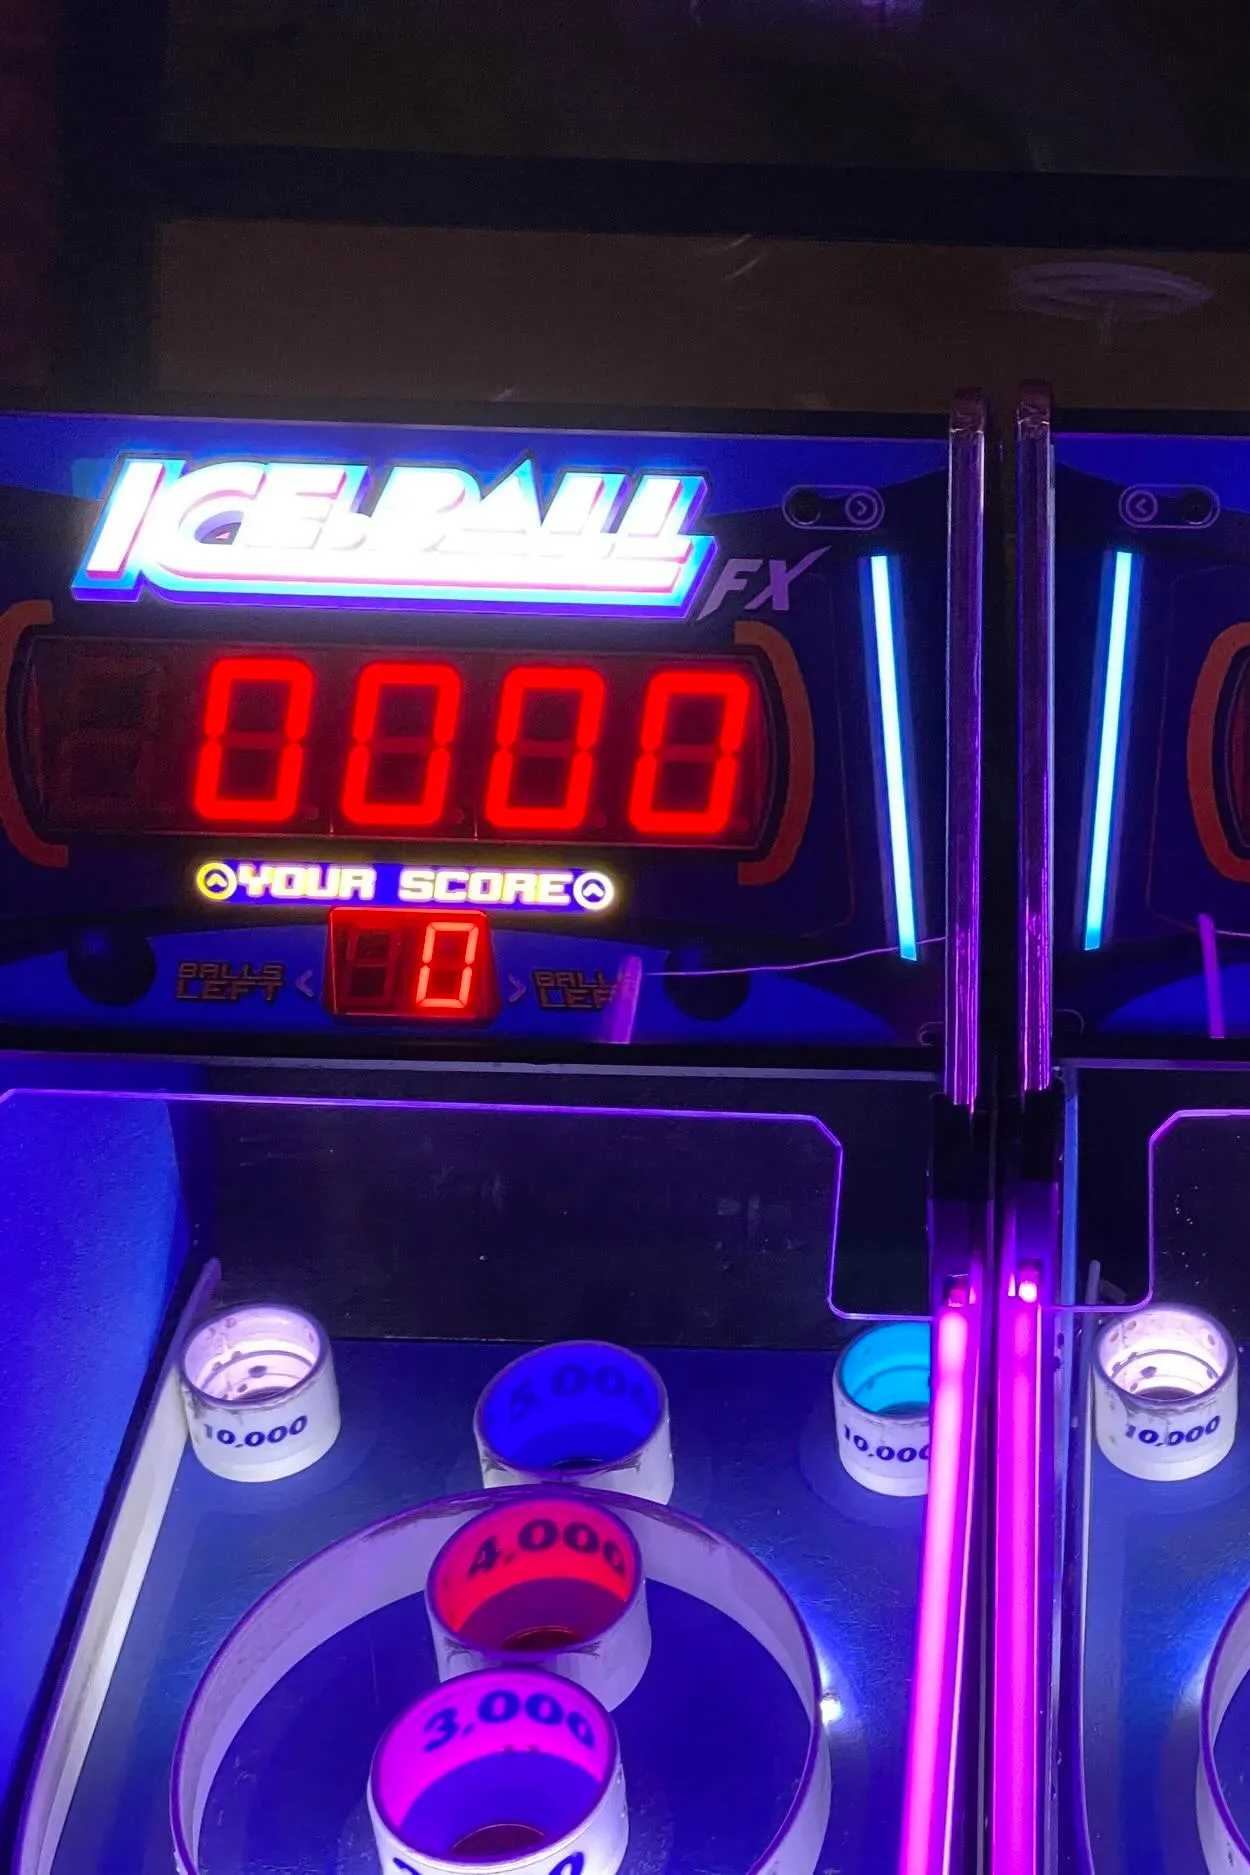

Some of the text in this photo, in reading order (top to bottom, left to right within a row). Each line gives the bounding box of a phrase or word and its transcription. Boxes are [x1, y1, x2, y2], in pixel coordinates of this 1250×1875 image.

[697, 547, 831, 622] FX
[237, 864, 574, 906] YOUR SCORE
[177, 961, 285, 981] BALLS
[415, 920, 481, 1010] 0
[532, 969, 637, 990] BALL
[174, 978, 285, 1001] LEFT
[537, 987, 628, 1010] LEF
[203, 1414, 308, 1448] 10,000
[1125, 1415, 1221, 1447] 10,000
[467, 1518, 626, 1580] 4,000
[423, 1689, 595, 1752] 3,000
